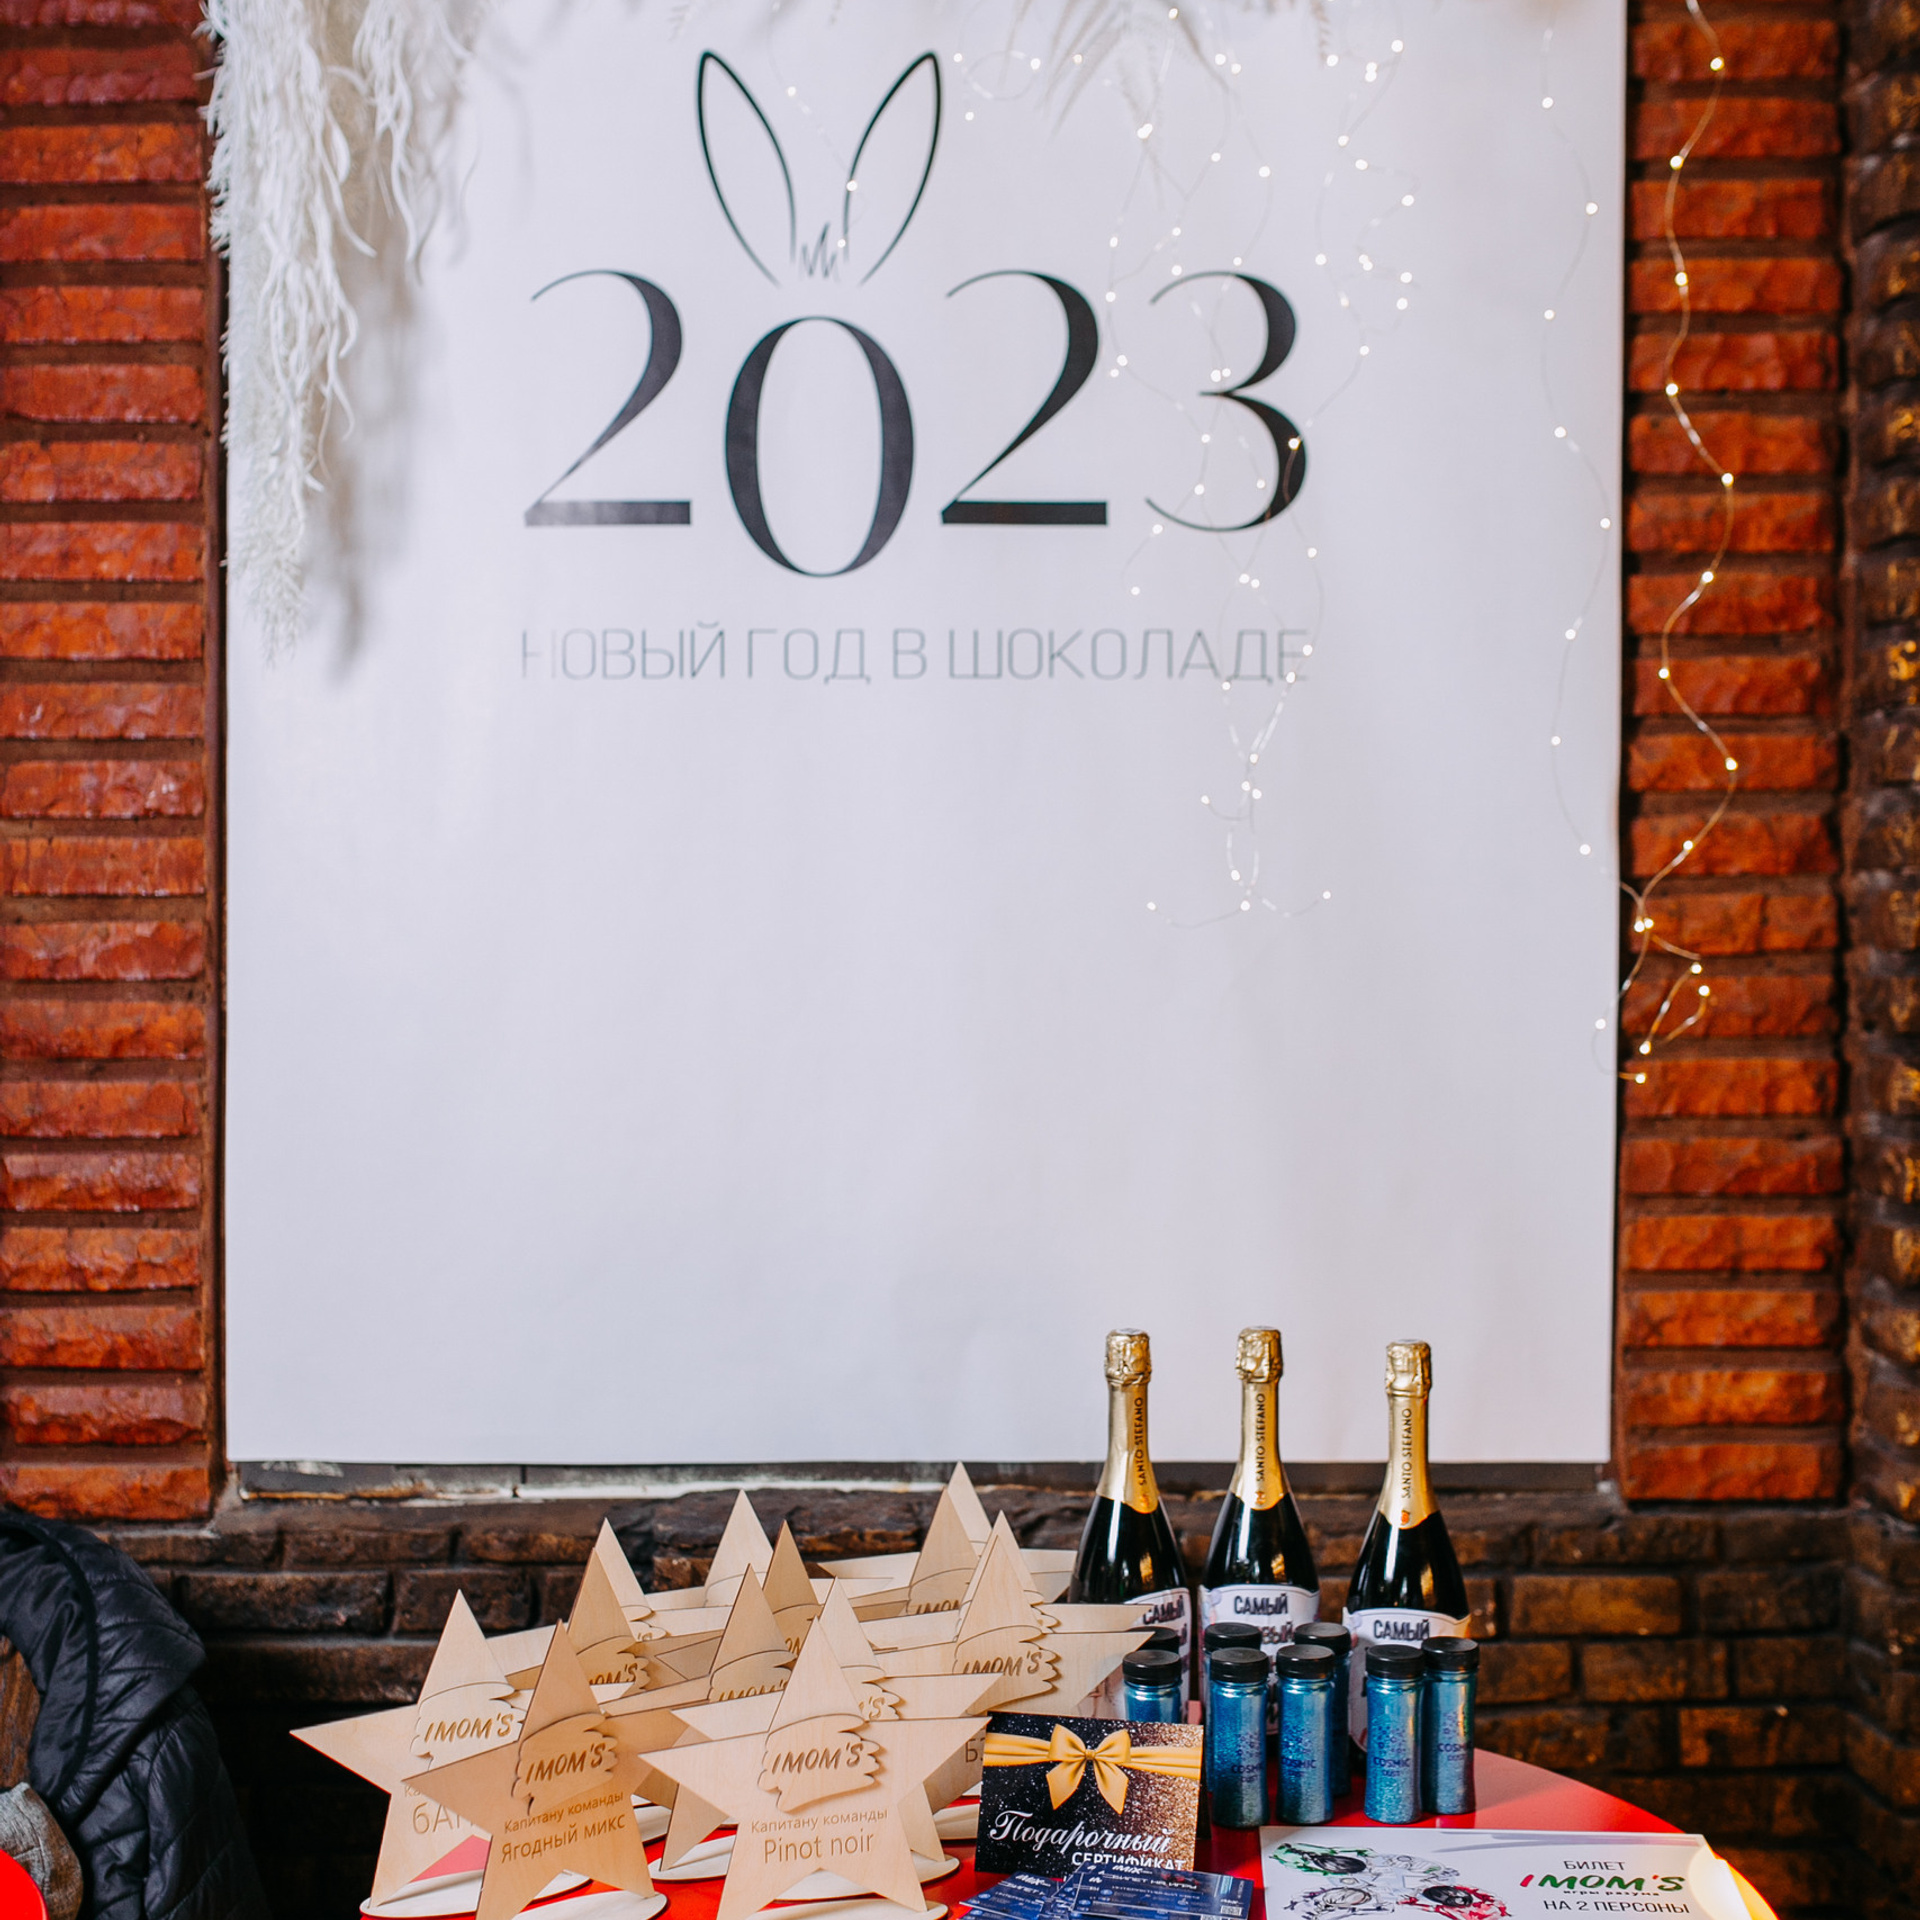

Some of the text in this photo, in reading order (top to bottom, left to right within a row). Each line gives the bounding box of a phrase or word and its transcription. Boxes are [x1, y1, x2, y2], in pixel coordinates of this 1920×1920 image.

[525, 271, 1308, 577] 2023
[522, 621, 1310, 686] НОВЫЙ ГОД В ШОКОЛАДЕ
[1134, 1397, 1147, 1486] SANTO STEFANO
[1256, 1393, 1266, 1482] SANTO STEFANO
[1401, 1408, 1412, 1499] SANTO STEFANO
[1234, 1593, 1288, 1616] САМЫЙ
[1374, 1619, 1430, 1641] САМЫЙ
[424, 1713, 514, 1742] IMOM'S
[525, 1742, 606, 1785] IMOM'S
[771, 1742, 864, 1775] IMOM'S
[504, 1791, 624, 1834] Капитану команды
[751, 1808, 888, 1833] Капитану команды
[989, 1810, 1176, 1854] Подарочный
[501, 1825, 578, 1864] Ягодный
[764, 1828, 874, 1863] Pinot noir
[1563, 1860, 1626, 1870] БИЛЕТ
[1543, 1901, 1691, 1913] НА 2 ПЕРСОНЫ
